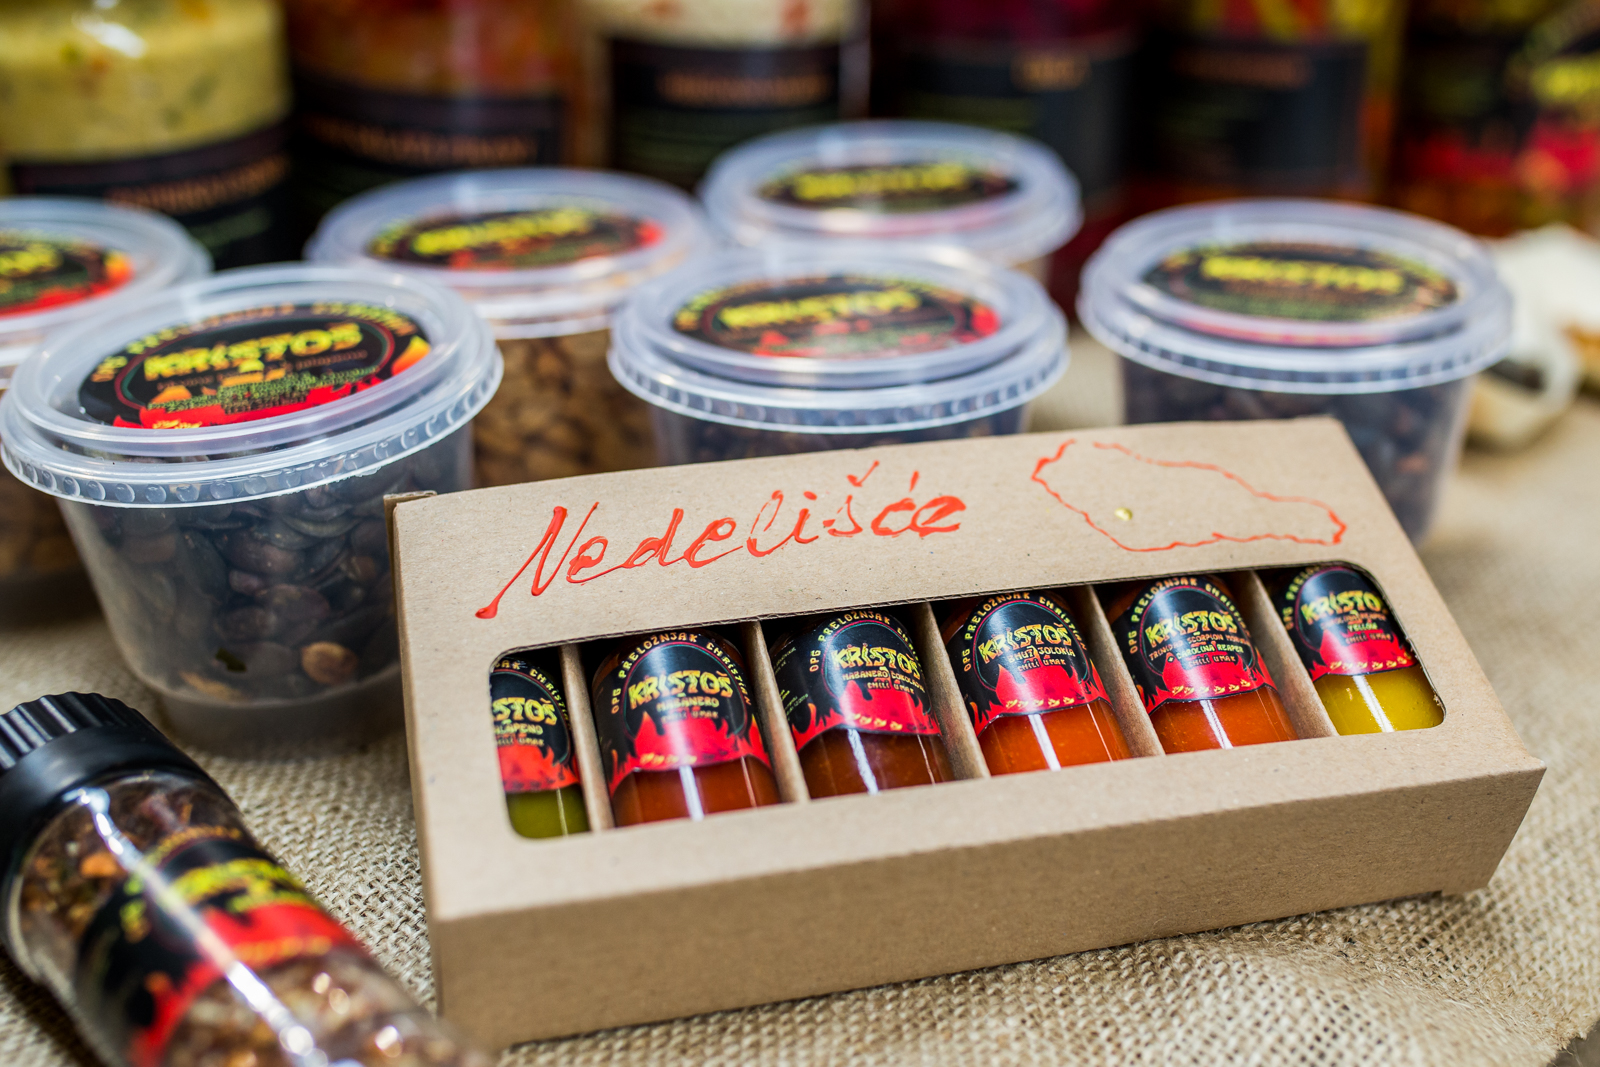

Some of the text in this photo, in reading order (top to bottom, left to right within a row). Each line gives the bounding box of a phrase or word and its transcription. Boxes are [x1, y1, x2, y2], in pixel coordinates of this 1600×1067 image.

[475, 460, 966, 619] Nedelišće
[1301, 590, 1389, 625] KRISTO
[1128, 630, 1139, 654] OPG
[1187, 633, 1224, 645] SCORPION
[1216, 643, 1244, 654] REAPER
[809, 649, 822, 673] OPG
[963, 648, 972, 672] OPG
[1038, 646, 1076, 658] JOLOKIA
[1043, 658, 1067, 667] UMAK
[1213, 655, 1236, 664] UMAK
[842, 669, 888, 682] HABANERO
[491, 697, 557, 726] STOŠ
[611, 688, 621, 714] OPG
